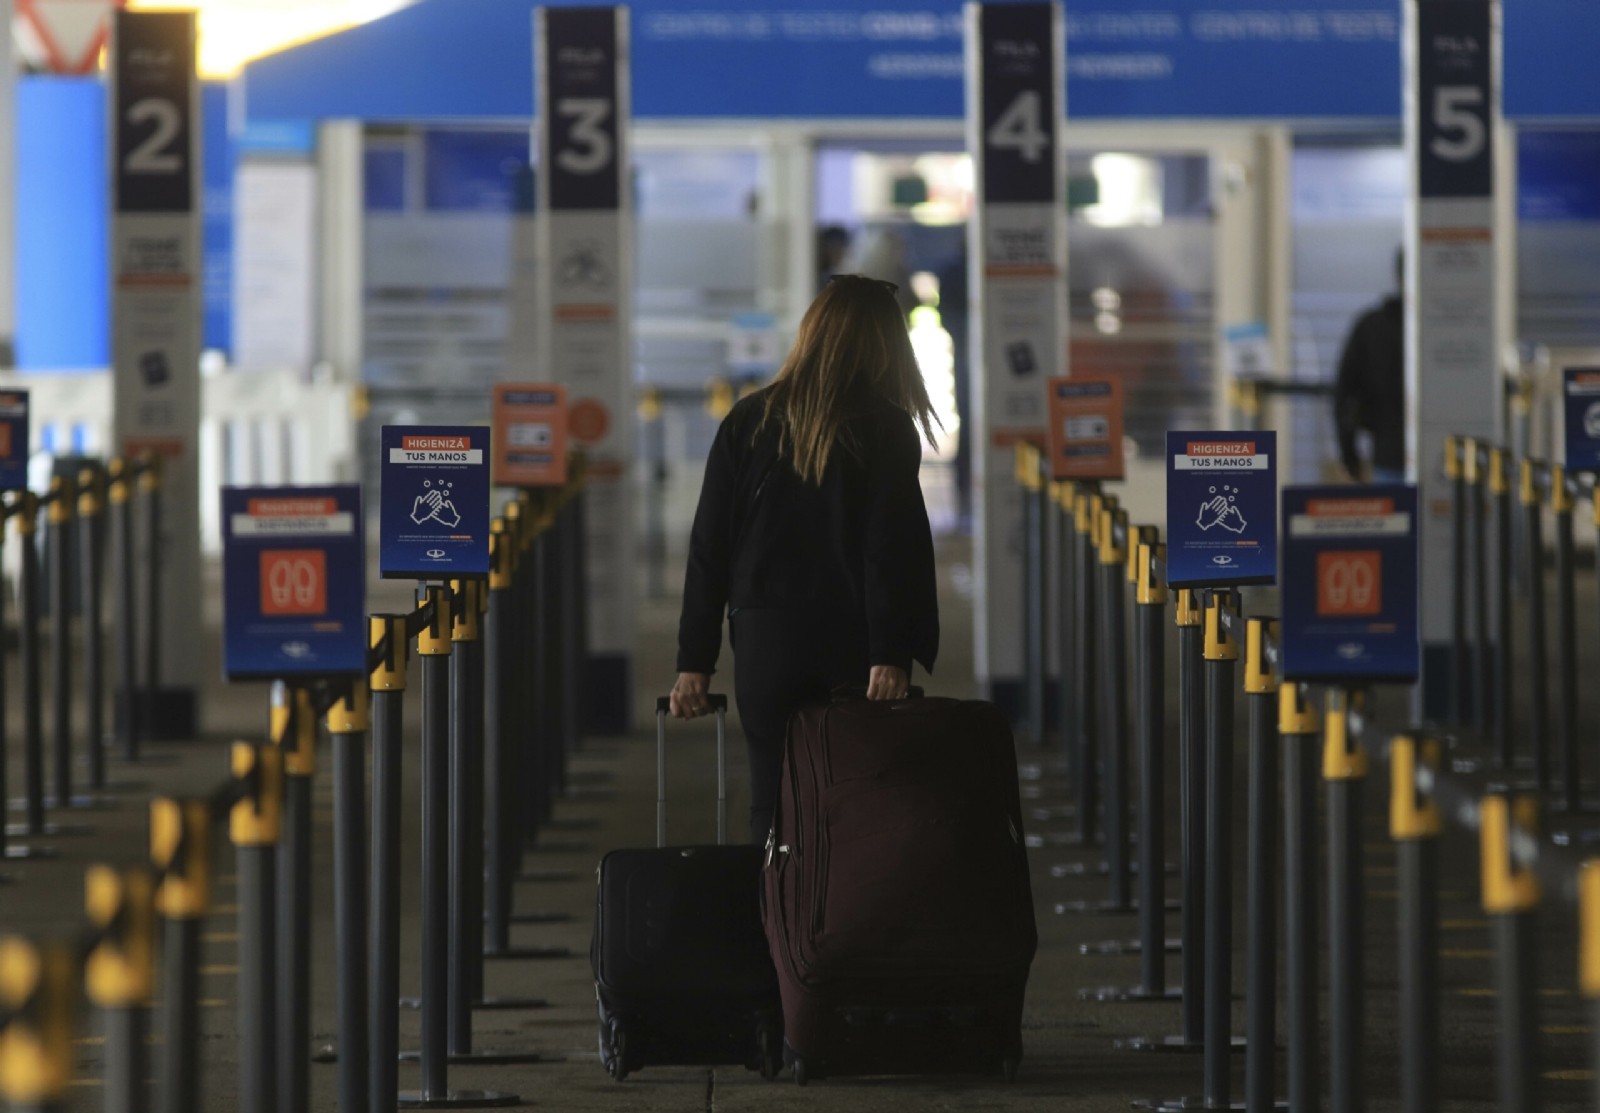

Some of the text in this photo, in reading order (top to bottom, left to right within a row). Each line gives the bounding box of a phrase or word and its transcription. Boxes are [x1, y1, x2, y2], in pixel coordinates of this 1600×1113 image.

[128, 99, 182, 172] 2
[558, 99, 610, 173] 3
[989, 91, 1048, 161] 4
[1431, 87, 1484, 160] 5
[406, 452, 467, 461] TUS MANOS
[408, 438, 464, 449] HIGIENIZÁ
[1191, 458, 1252, 467] TUS MANOS
[1193, 443, 1250, 454] HIGIENIZÁ
